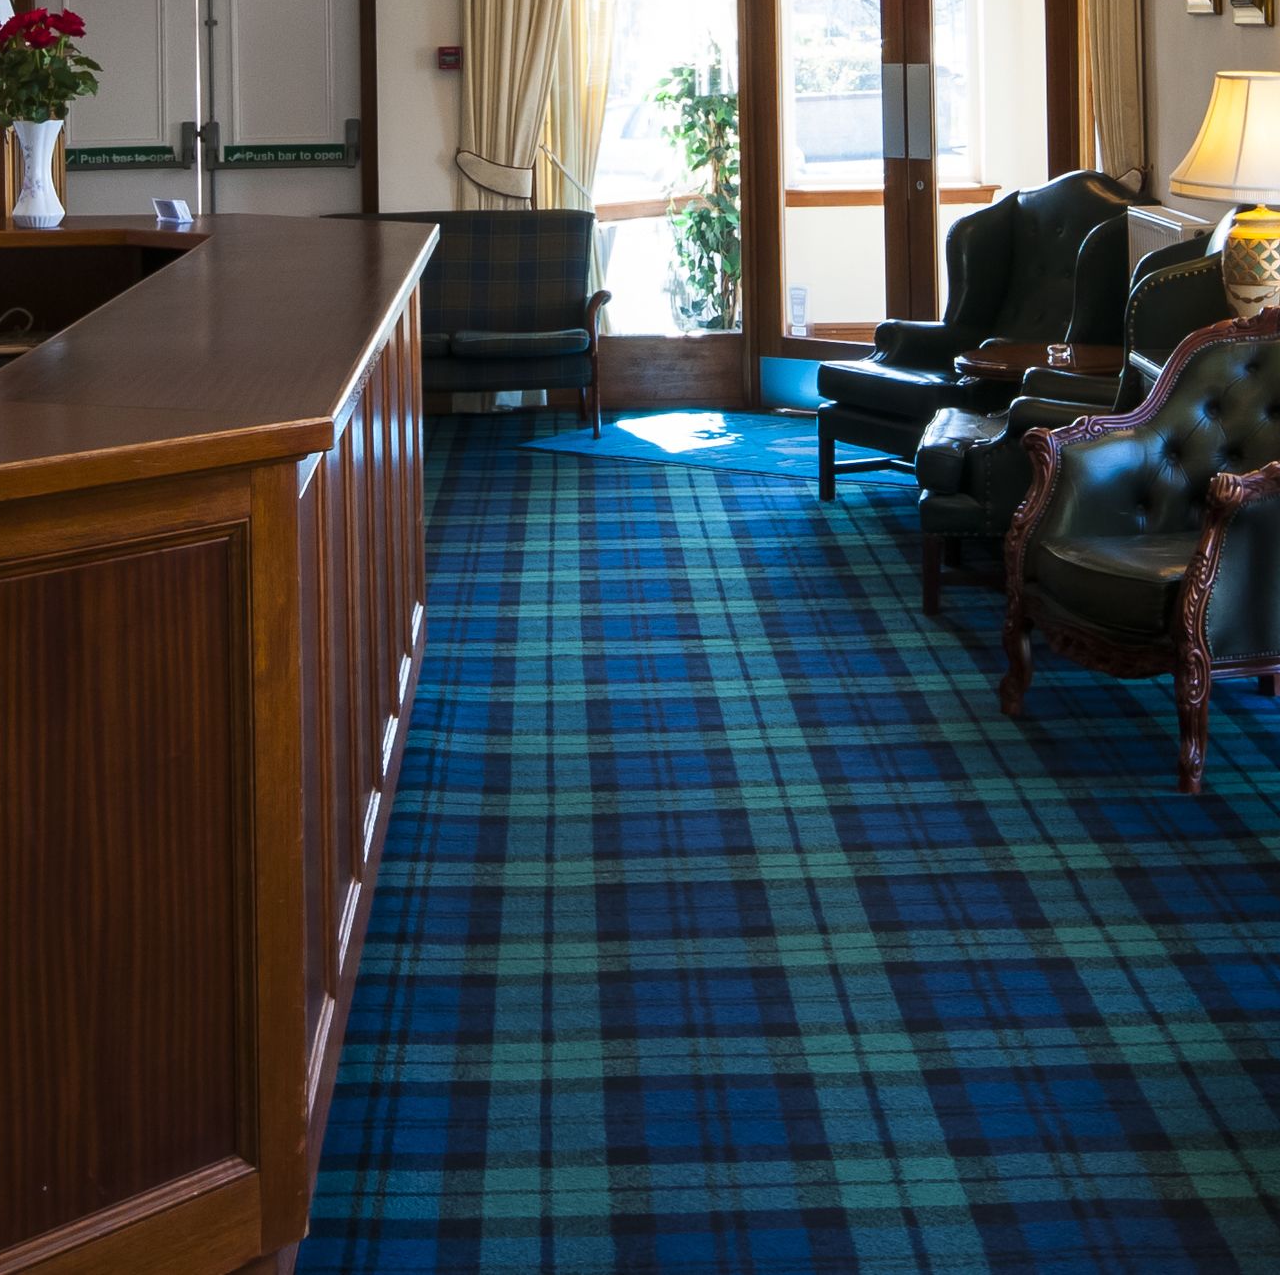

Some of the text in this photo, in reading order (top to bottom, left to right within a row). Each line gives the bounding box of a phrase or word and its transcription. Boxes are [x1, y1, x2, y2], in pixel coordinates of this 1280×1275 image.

[80, 154, 109, 164] Push
[112, 154, 131, 163] bar
[135, 153, 146, 163] to
[246, 151, 343, 162] Push bar to open
